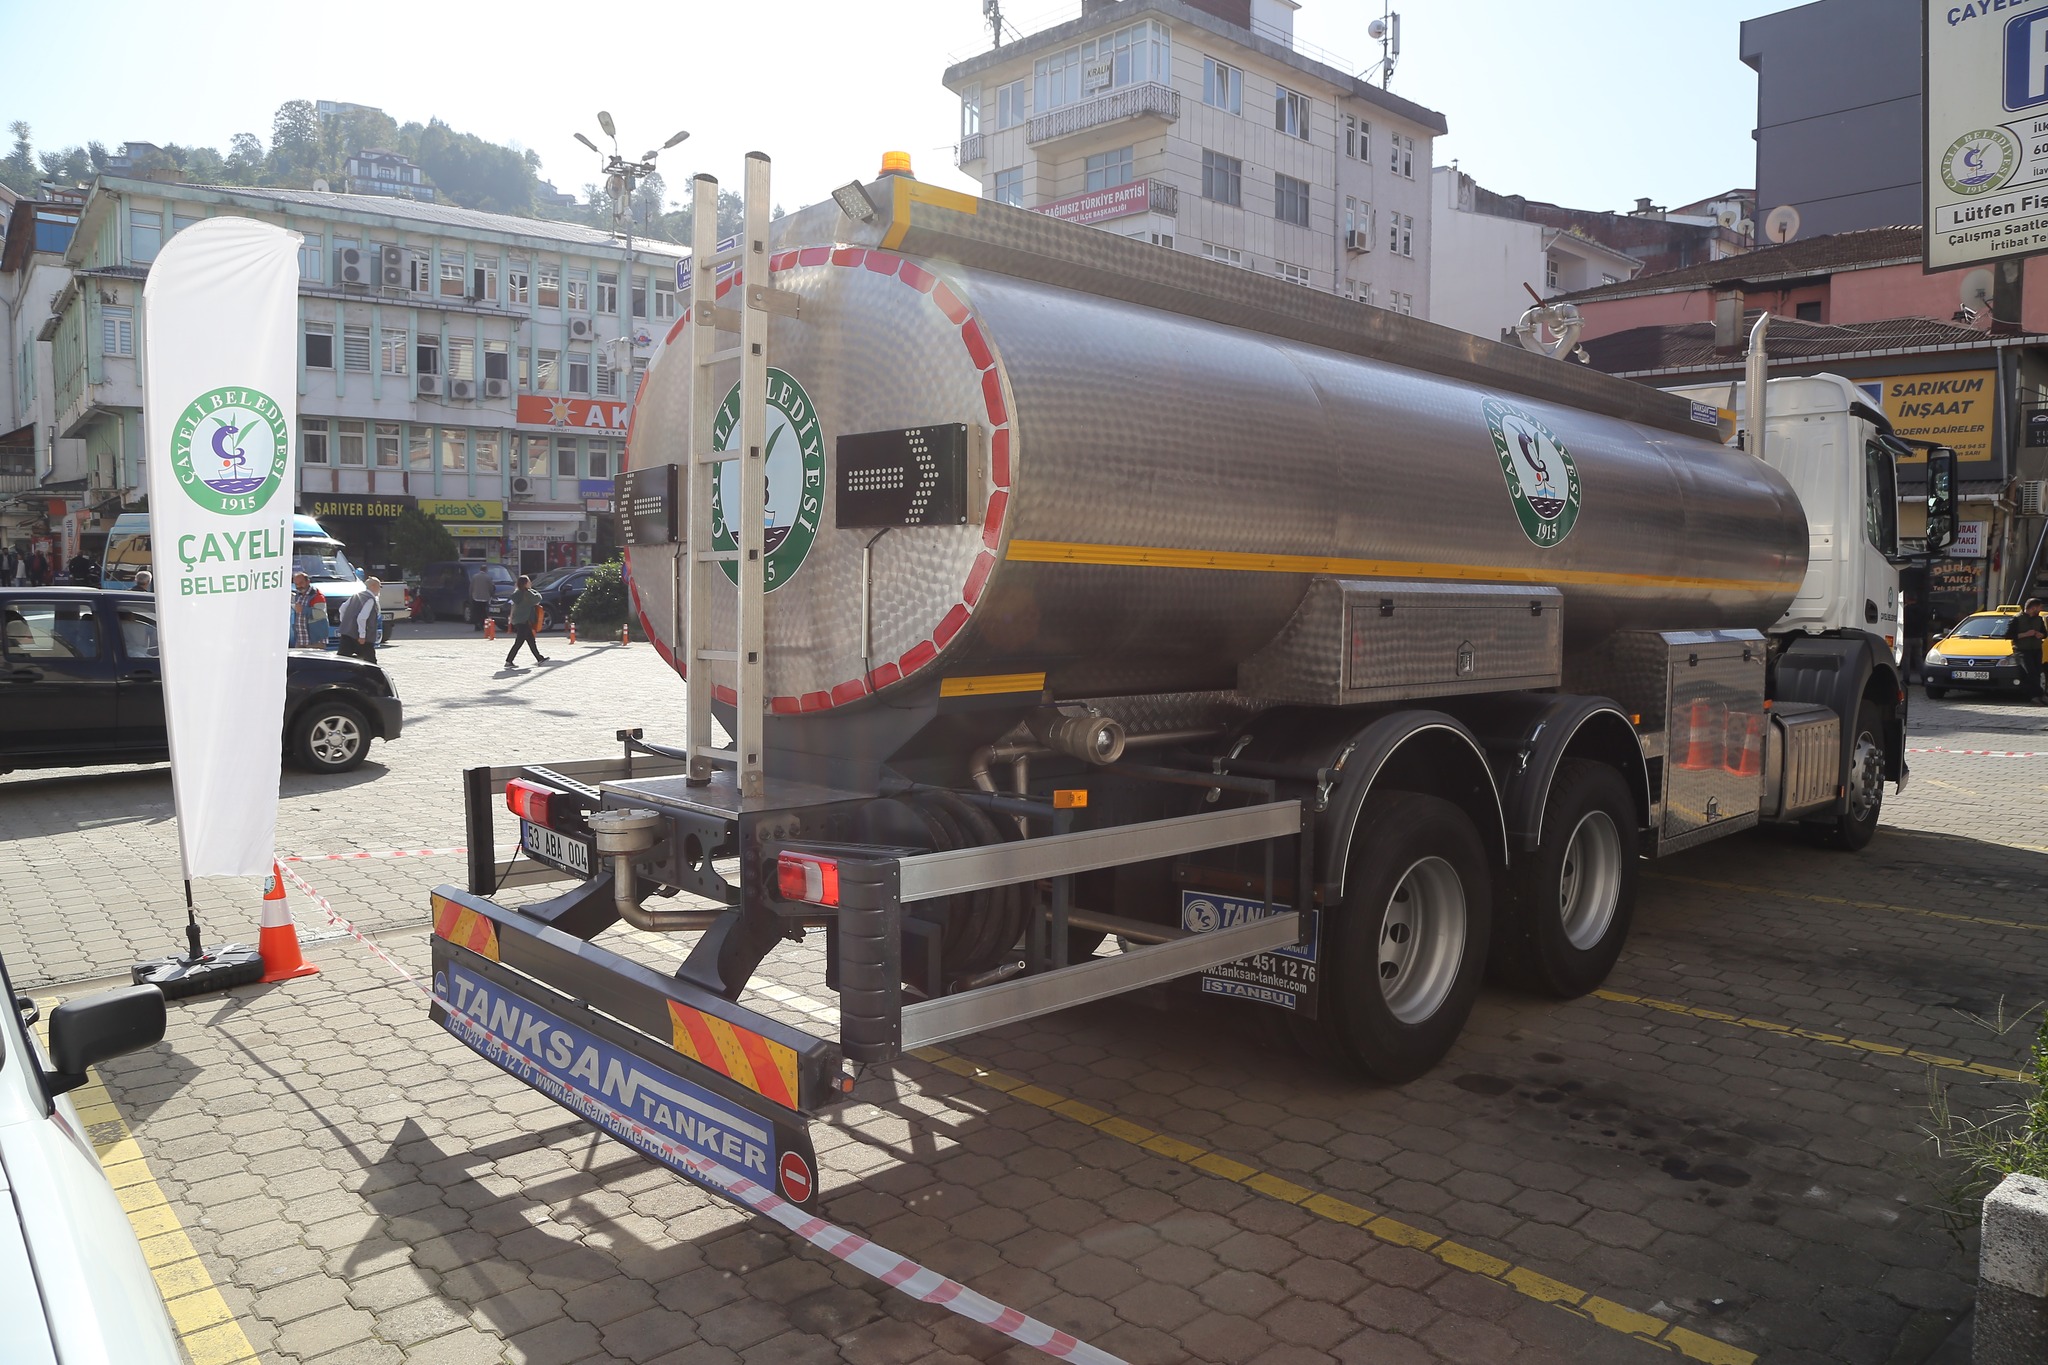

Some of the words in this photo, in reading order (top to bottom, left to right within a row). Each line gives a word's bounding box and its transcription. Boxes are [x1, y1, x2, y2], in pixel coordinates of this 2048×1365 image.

[1081, 193, 1114, 210] TÜRKİYE
[1115, 183, 1145, 203] PARTİSİ
[1966, 183, 1988, 194] 1915
[1093, 205, 1127, 218] BAŞKANLIĞI
[1953, 204, 2015, 224] Lütfen
[1948, 229, 2001, 246] Çalışma
[1891, 378, 1984, 397] SARIKUM
[1899, 400, 1974, 418] İNŞAAT
[177, 402, 207, 485] ÇAYELİ
[210, 391, 287, 484] BELEDİYESİ
[1932, 424, 1985, 434] DAİRELER
[220, 495, 256, 511] 1915
[314, 502, 363, 516] SARIYER
[367, 500, 404, 517] BÖREK
[435, 504, 467, 516] iddaa
[1536, 523, 1557, 539] 1915
[178, 519, 285, 572] ÇAYELİ
[180, 566, 284, 595] BELEDİYESİ
[1943, 574, 1973, 583] TAKSİ
[529, 825, 541, 850] 53
[545, 832, 563, 860] ABA
[568, 841, 588, 870] 004
[1252, 954, 1276, 973] 451
[1282, 960, 1298, 978] 12
[1301, 964, 1316, 983] 76
[454, 974, 642, 1108] TANKSAN
[640, 1092, 768, 1175] TANKER
